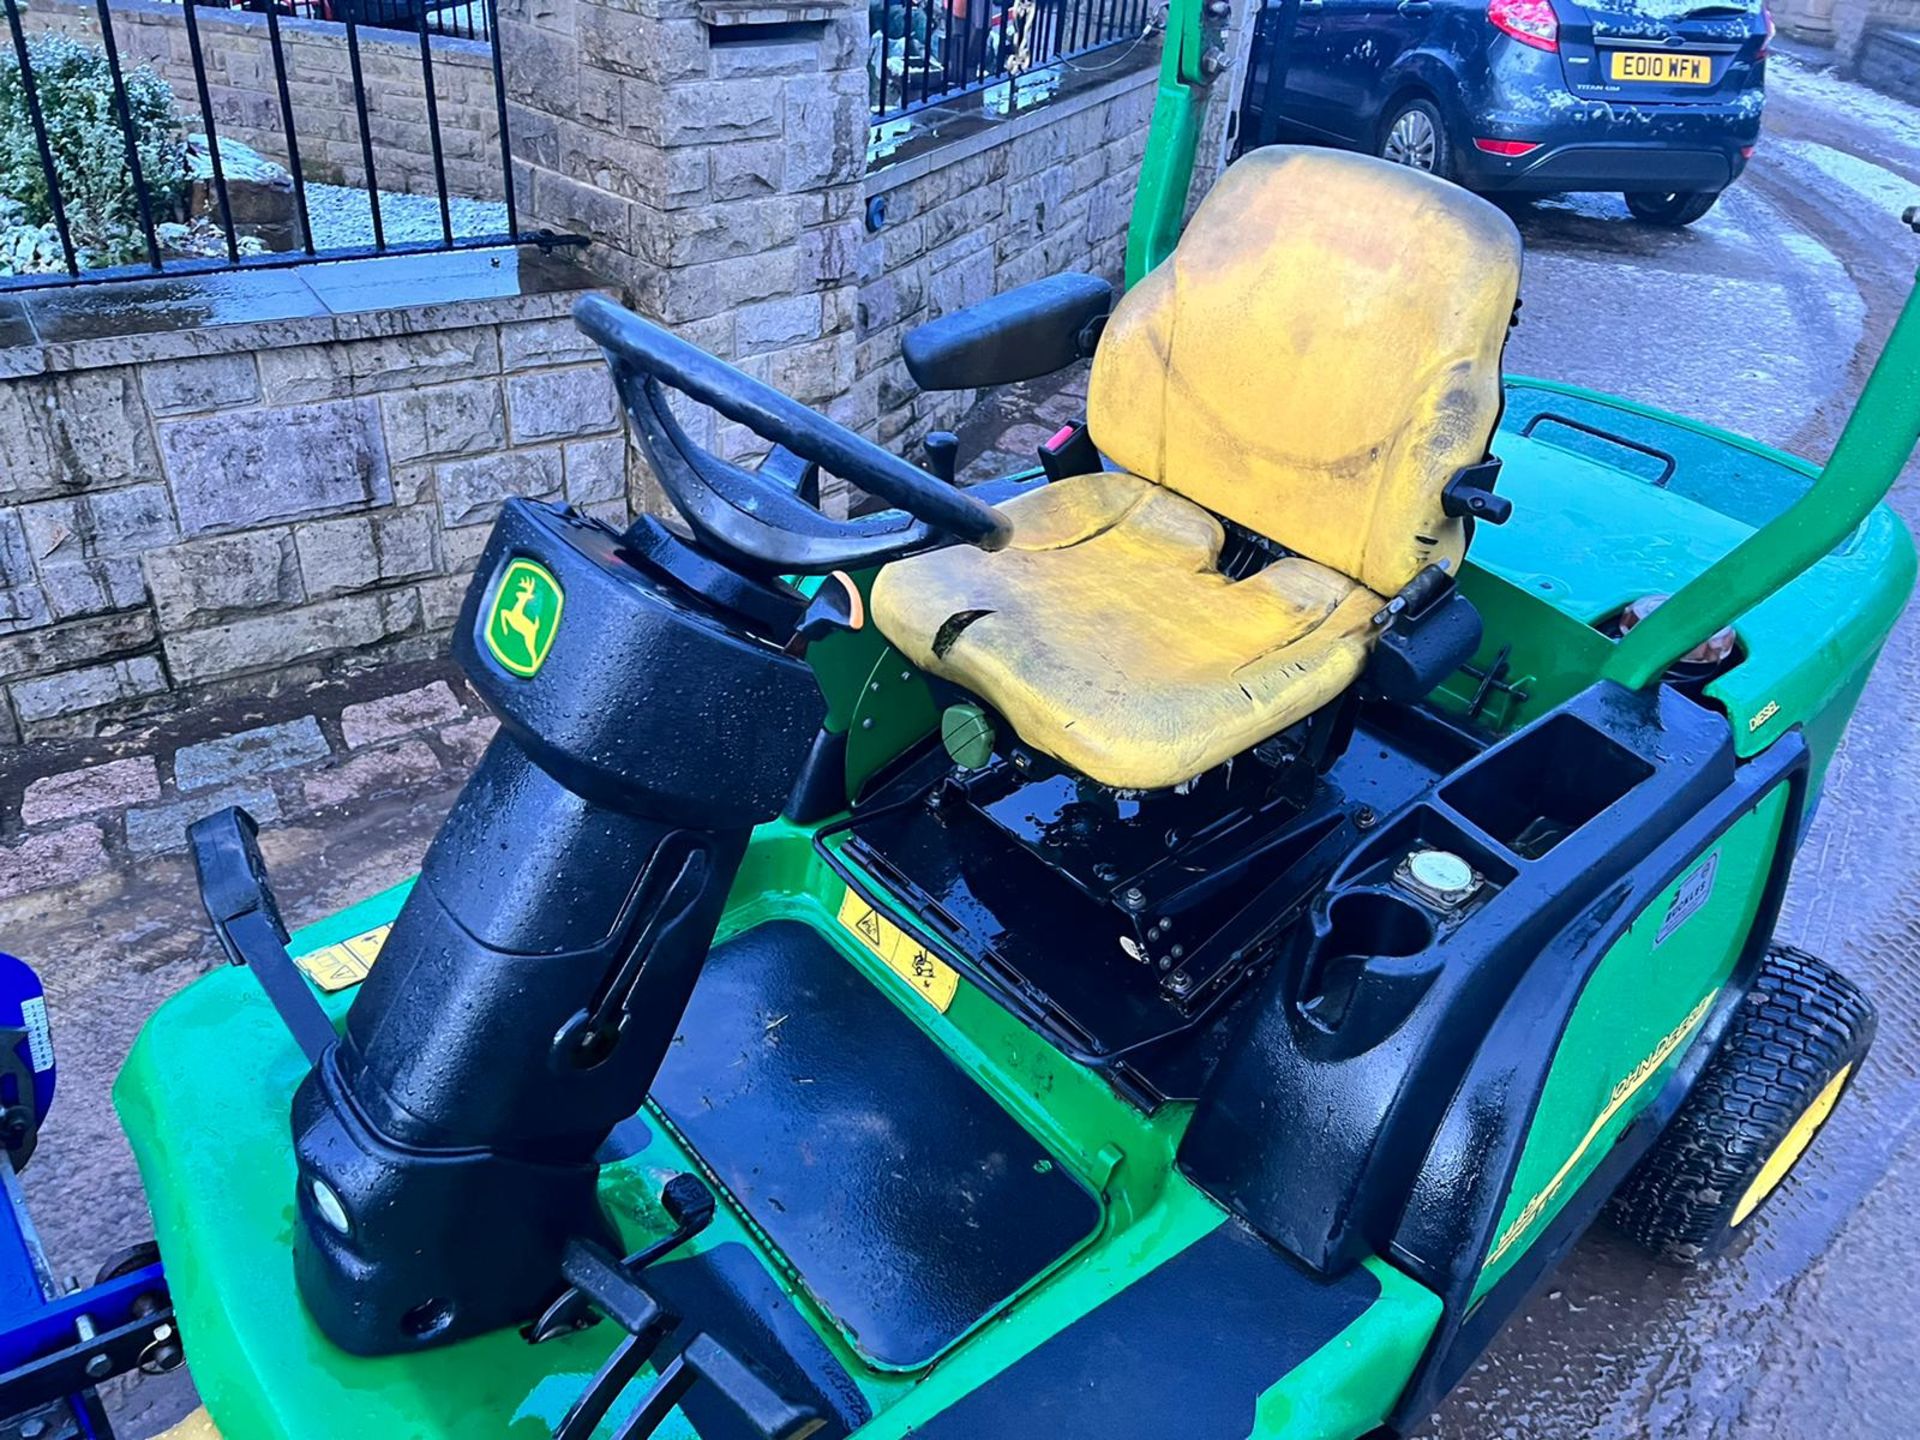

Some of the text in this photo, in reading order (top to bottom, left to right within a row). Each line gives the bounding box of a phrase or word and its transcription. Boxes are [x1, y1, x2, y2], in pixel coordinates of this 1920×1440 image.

[1668, 58, 1701, 79] WFW
[1749, 700, 1781, 732] DIESEL
[1607, 996, 1709, 1109] JOHN DEERE
